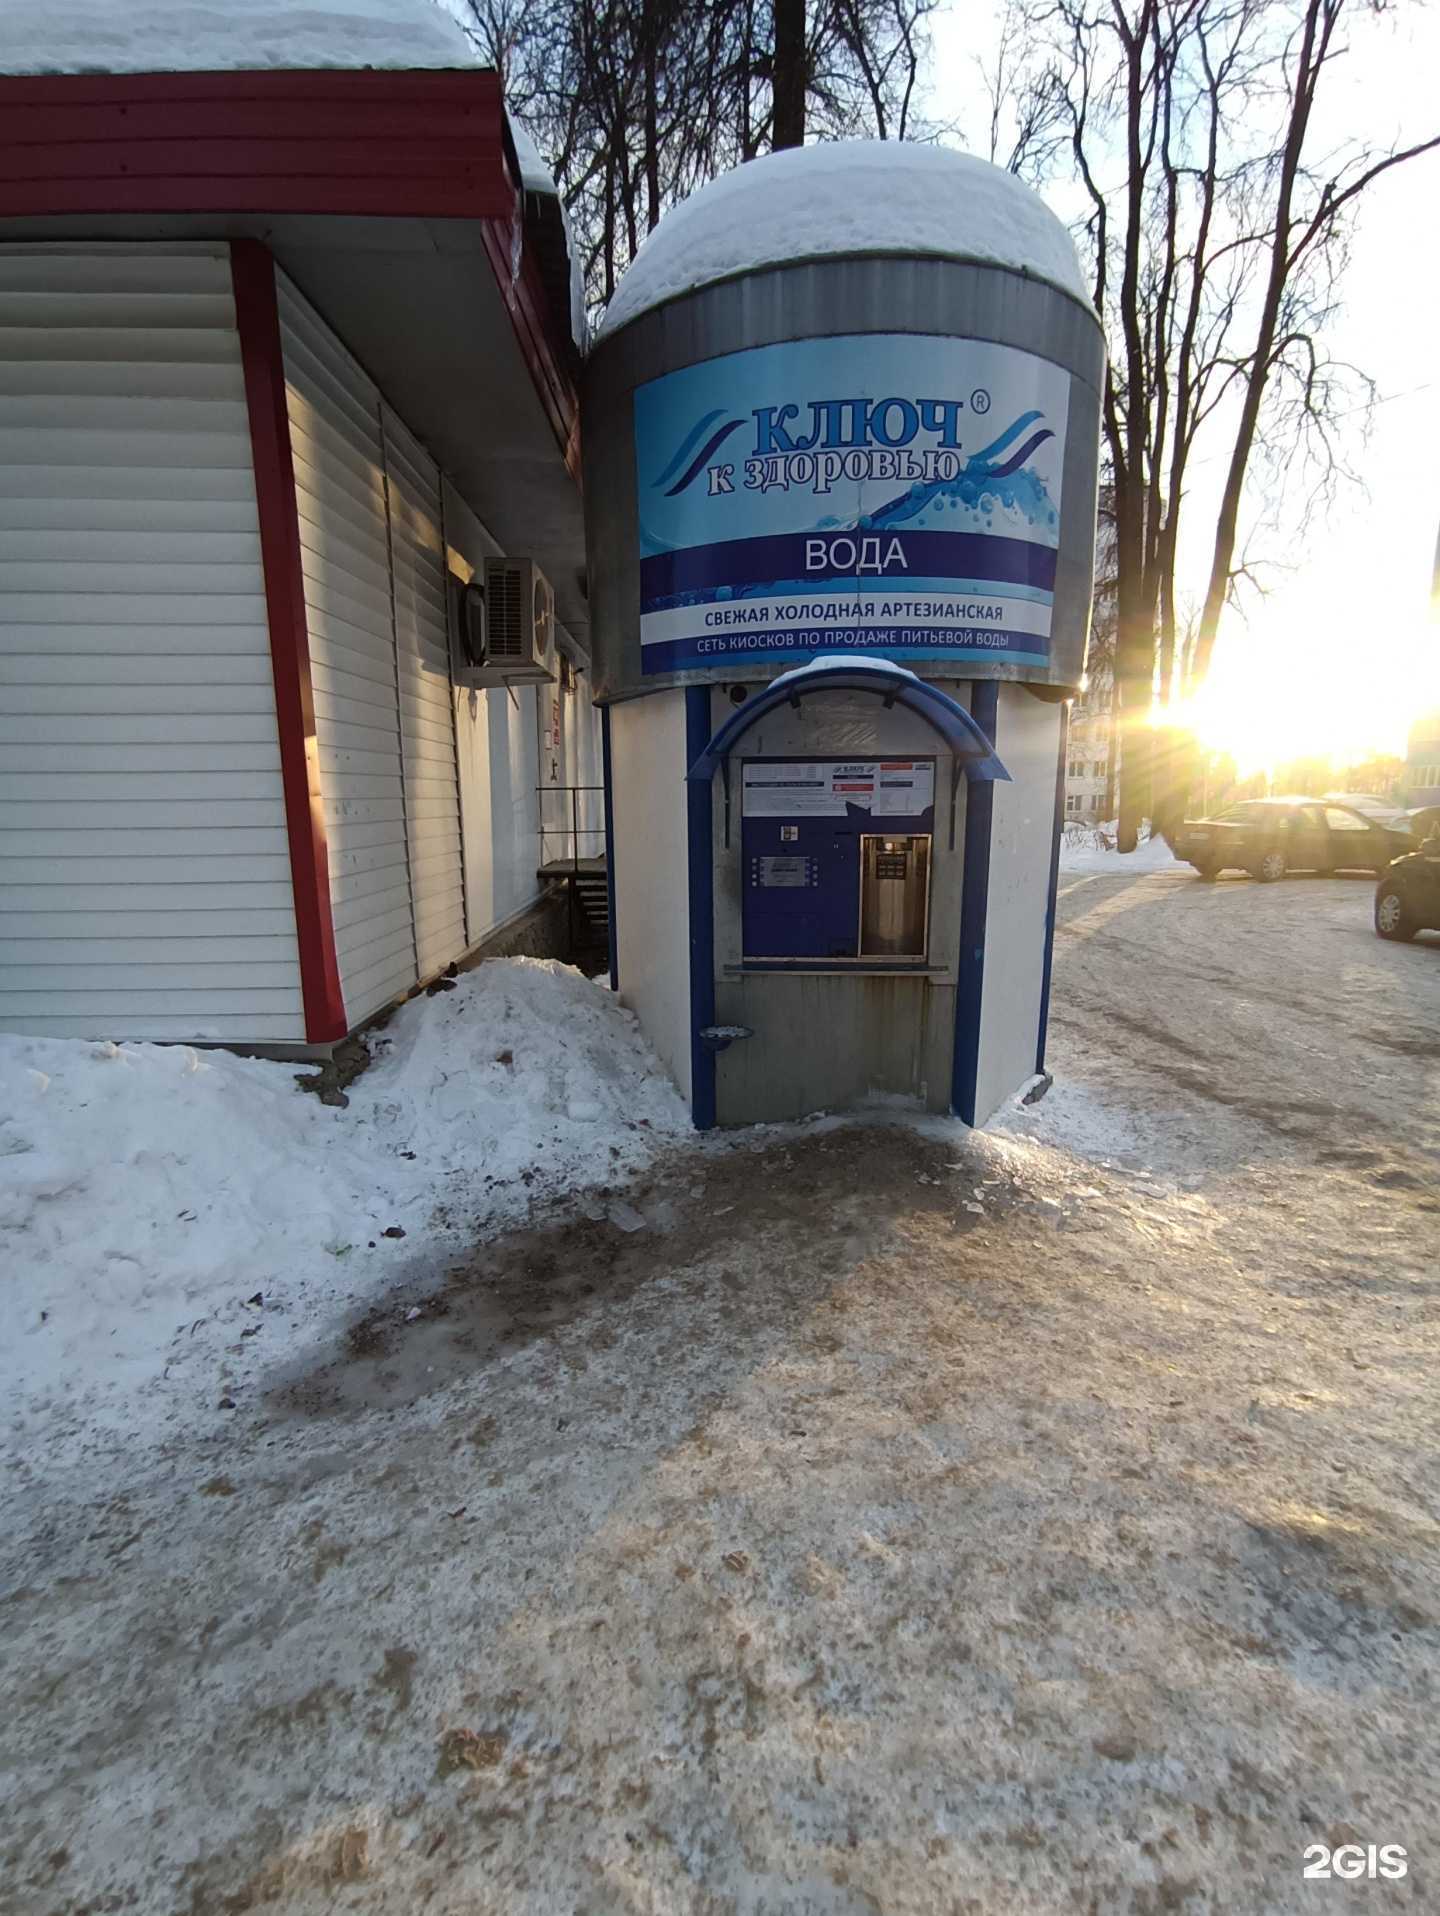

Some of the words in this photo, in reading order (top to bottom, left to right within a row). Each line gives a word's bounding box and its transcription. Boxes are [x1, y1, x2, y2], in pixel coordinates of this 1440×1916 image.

[752, 397, 963, 456] КЛЮЧ
[744, 449, 961, 494] здоровью
[805, 537, 908, 575] ВОДА
[705, 606, 769, 626] СВЕЖАЯ
[775, 602, 875, 621] ХОЛОДНАЯ
[880, 602, 1003, 621] АРТЕЗИАНСКАЯ
[697, 638, 726, 653] СЕТЬ
[729, 633, 794, 650] КИОСКОВ
[799, 632, 820, 645] ПО
[824, 630, 897, 646] ПРОДАЖЕ
[901, 629, 973, 645] ПИТЬЕВОЙ
[976, 632, 1009, 649] ВОДЫ
